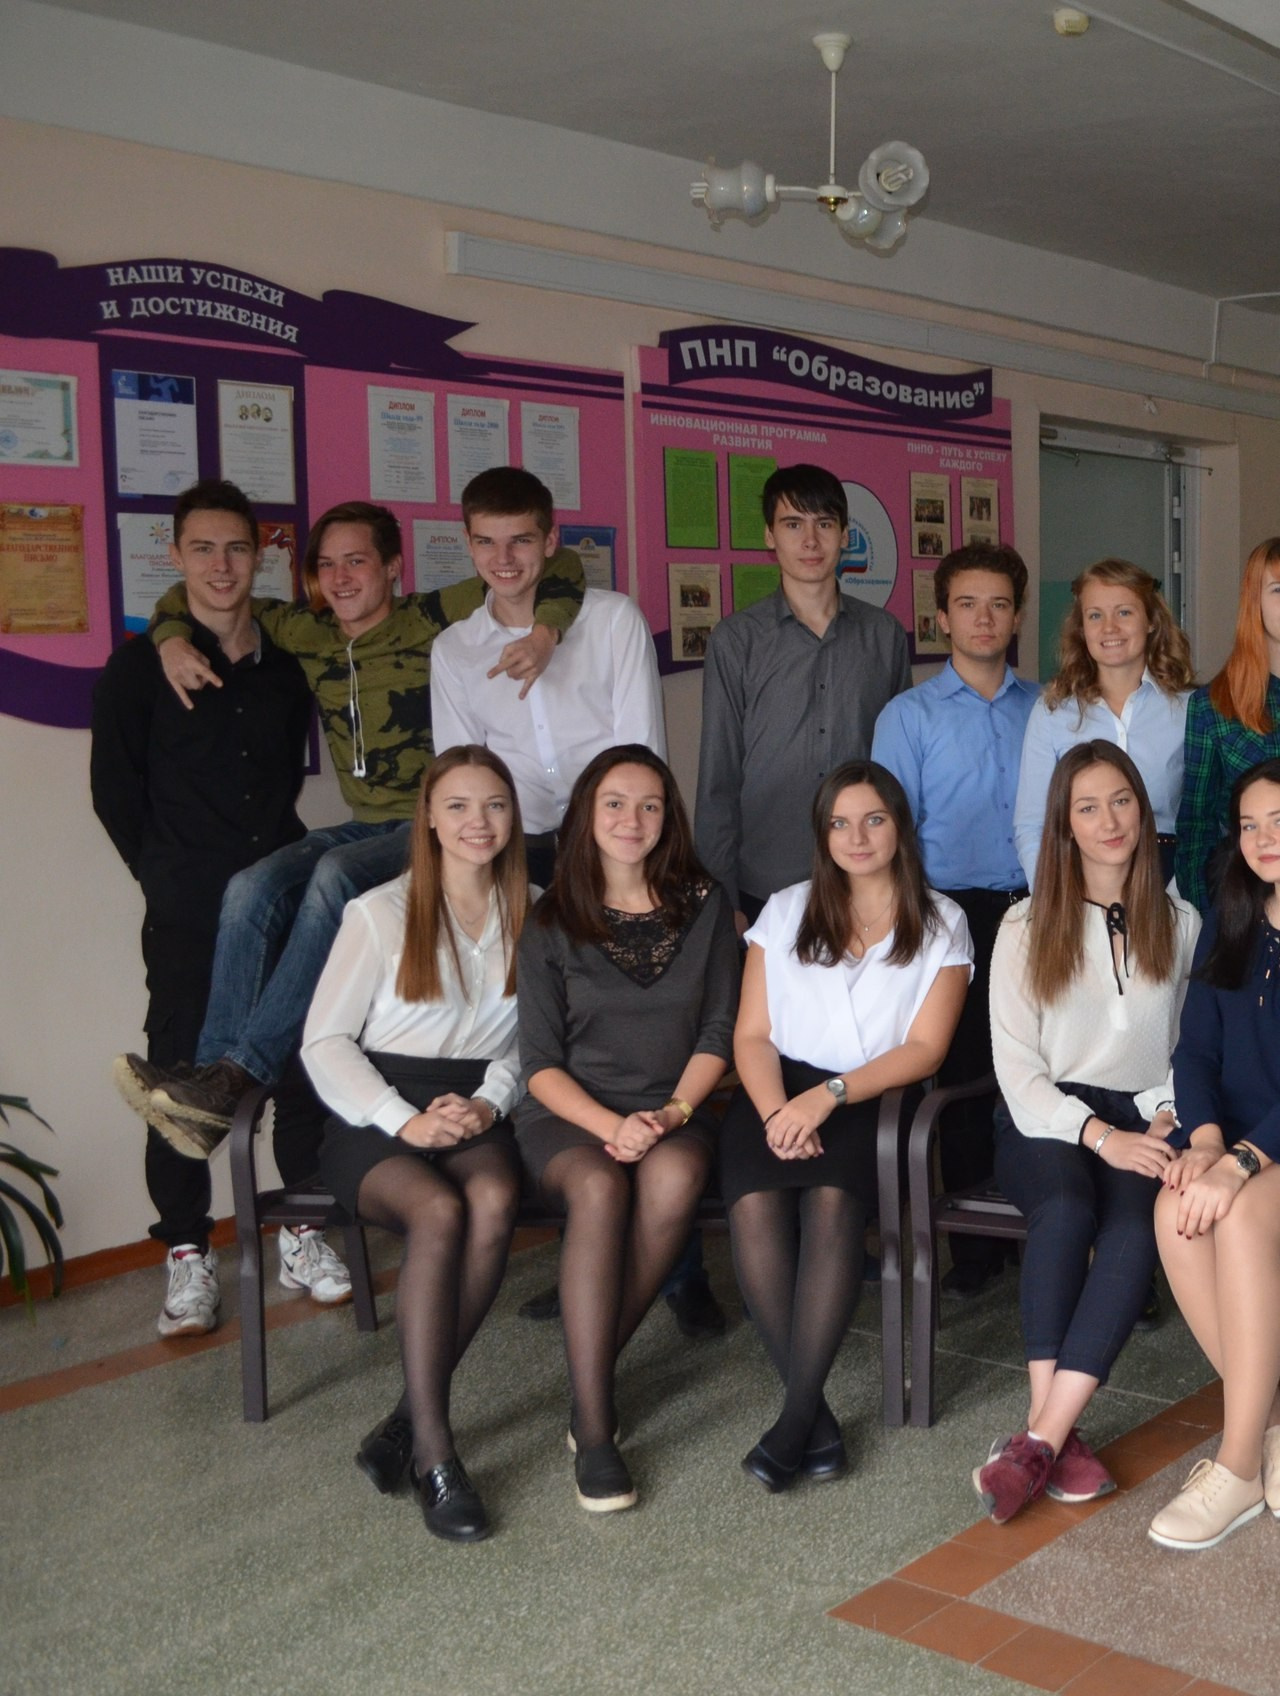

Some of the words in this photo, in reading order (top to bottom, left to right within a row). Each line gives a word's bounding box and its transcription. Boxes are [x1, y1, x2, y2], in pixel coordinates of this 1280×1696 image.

[107, 265, 184, 286] НАШИ
[190, 267, 285, 308] УСПЕХИ
[100, 300, 120, 319] И
[130, 297, 299, 343] ДОСТИЖЕНИЯ
[679, 338, 757, 370] ПНП
[388, 401, 415, 411] ДИПЛОМ
[461, 408, 486, 417] ДИПЛОМ
[650, 413, 757, 436] ИННОВАЦИОННАЯ
[761, 426, 827, 443] ПРОГРАММА
[713, 434, 773, 450] РАЗВИТИЯ
[907, 442, 934, 455] ПНПО
[941, 446, 964, 457] ПУТЬ
[966, 449, 973, 458] К
[974, 450, 1007, 463] УСПЕХУ
[939, 458, 983, 472] КАЖДОГО
[430, 535, 458, 544] ДИПЛОМ
